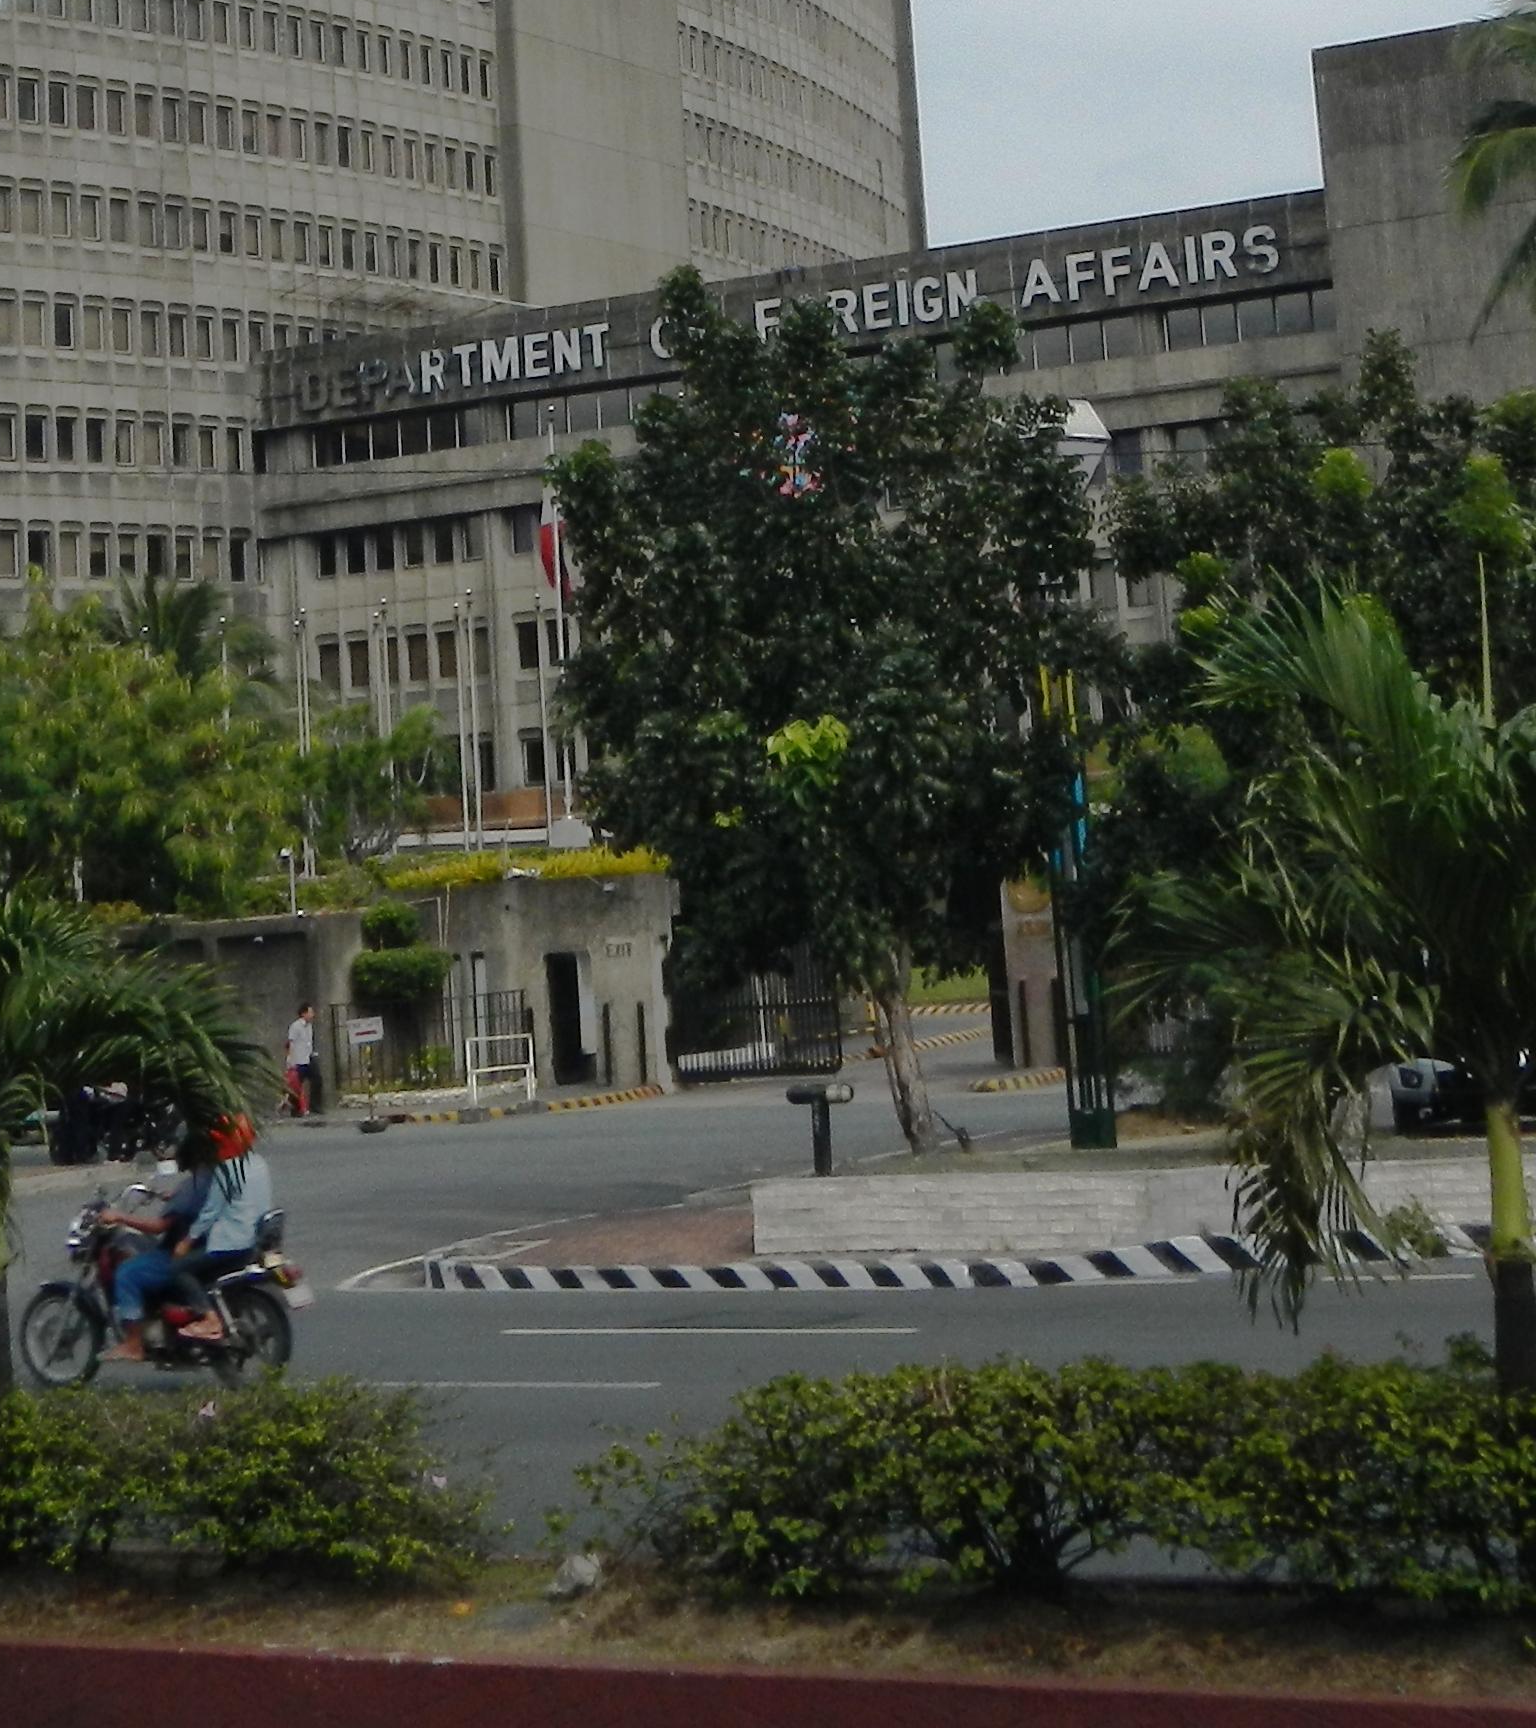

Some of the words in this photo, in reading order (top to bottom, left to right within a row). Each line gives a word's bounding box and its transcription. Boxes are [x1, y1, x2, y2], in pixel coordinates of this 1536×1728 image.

[299, 322, 610, 412] DEPARTMENT
[649, 310, 707, 360] O
[754, 269, 977, 344] FREIGN
[1020, 224, 1280, 309] AFFAIRS
